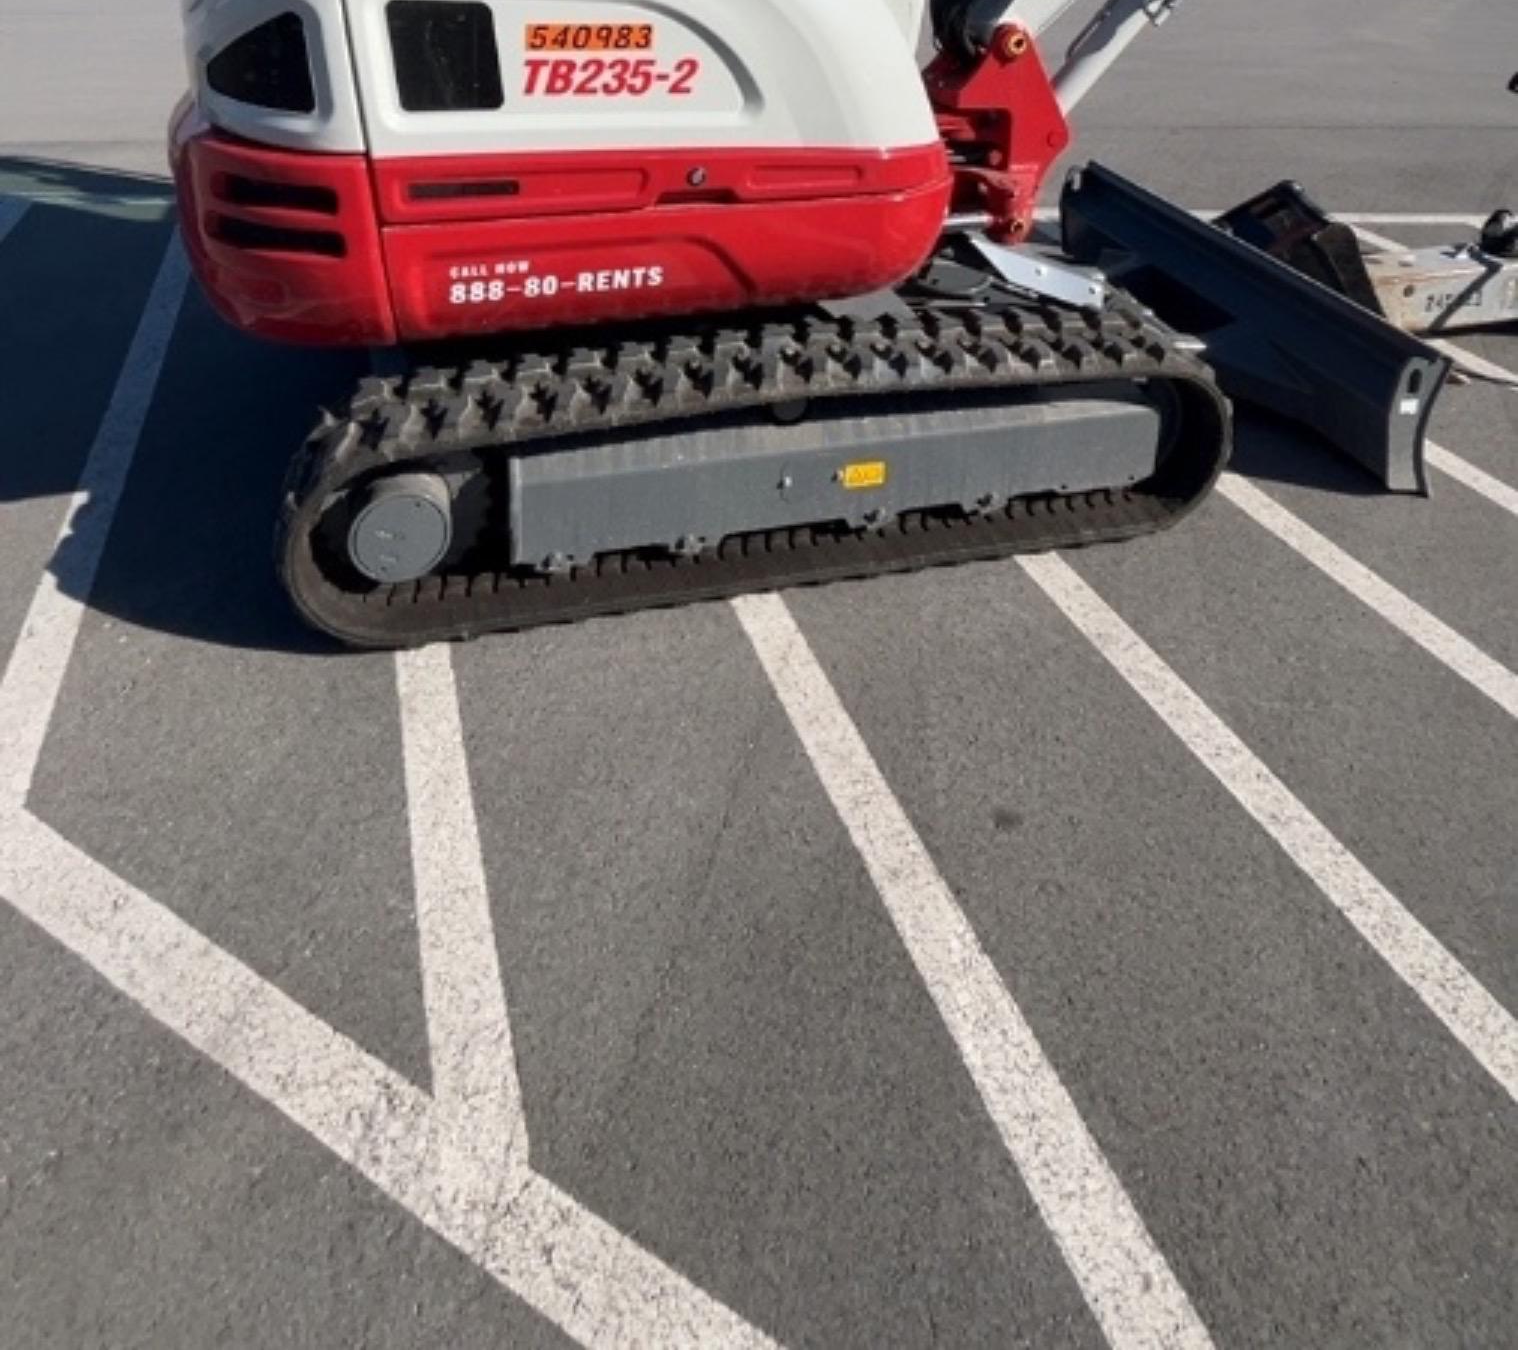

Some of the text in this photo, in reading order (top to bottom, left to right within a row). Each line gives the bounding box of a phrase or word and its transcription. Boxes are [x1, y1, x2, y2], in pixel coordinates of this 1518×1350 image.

[529, 24, 652, 49] 540983
[524, 58, 698, 96] TB235-2
[450, 261, 530, 279] CALL NOW
[450, 266, 664, 304] 888-80-RENTS
